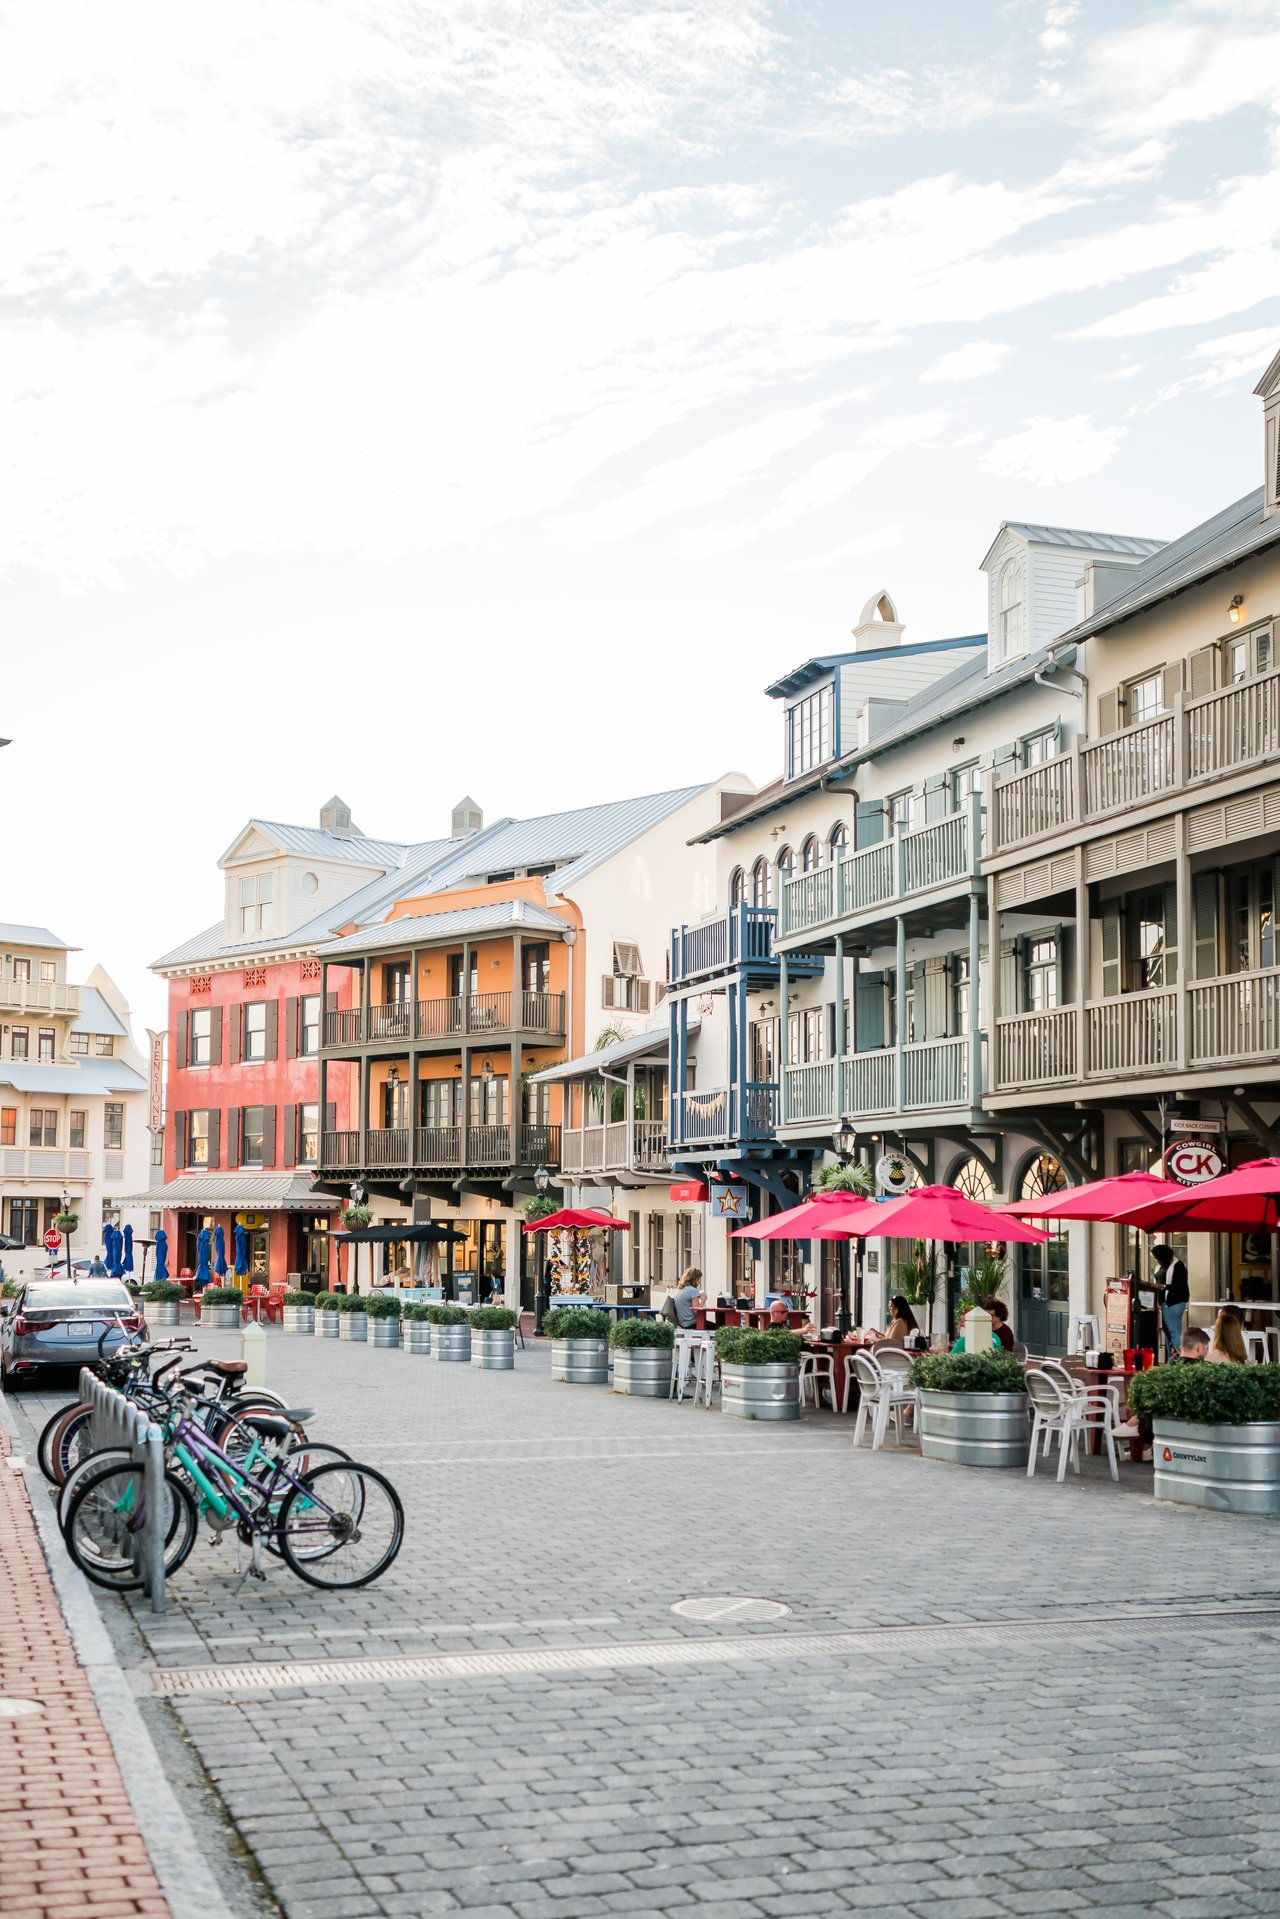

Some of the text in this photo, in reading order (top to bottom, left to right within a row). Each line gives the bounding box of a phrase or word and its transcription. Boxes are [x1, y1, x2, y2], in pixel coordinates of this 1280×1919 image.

[152, 1040, 160, 1125] PENSIONE
[1176, 1141, 1217, 1153] COWGIRL
[1176, 1153, 1215, 1175] CK
[45, 1235, 60, 1243] STOP
